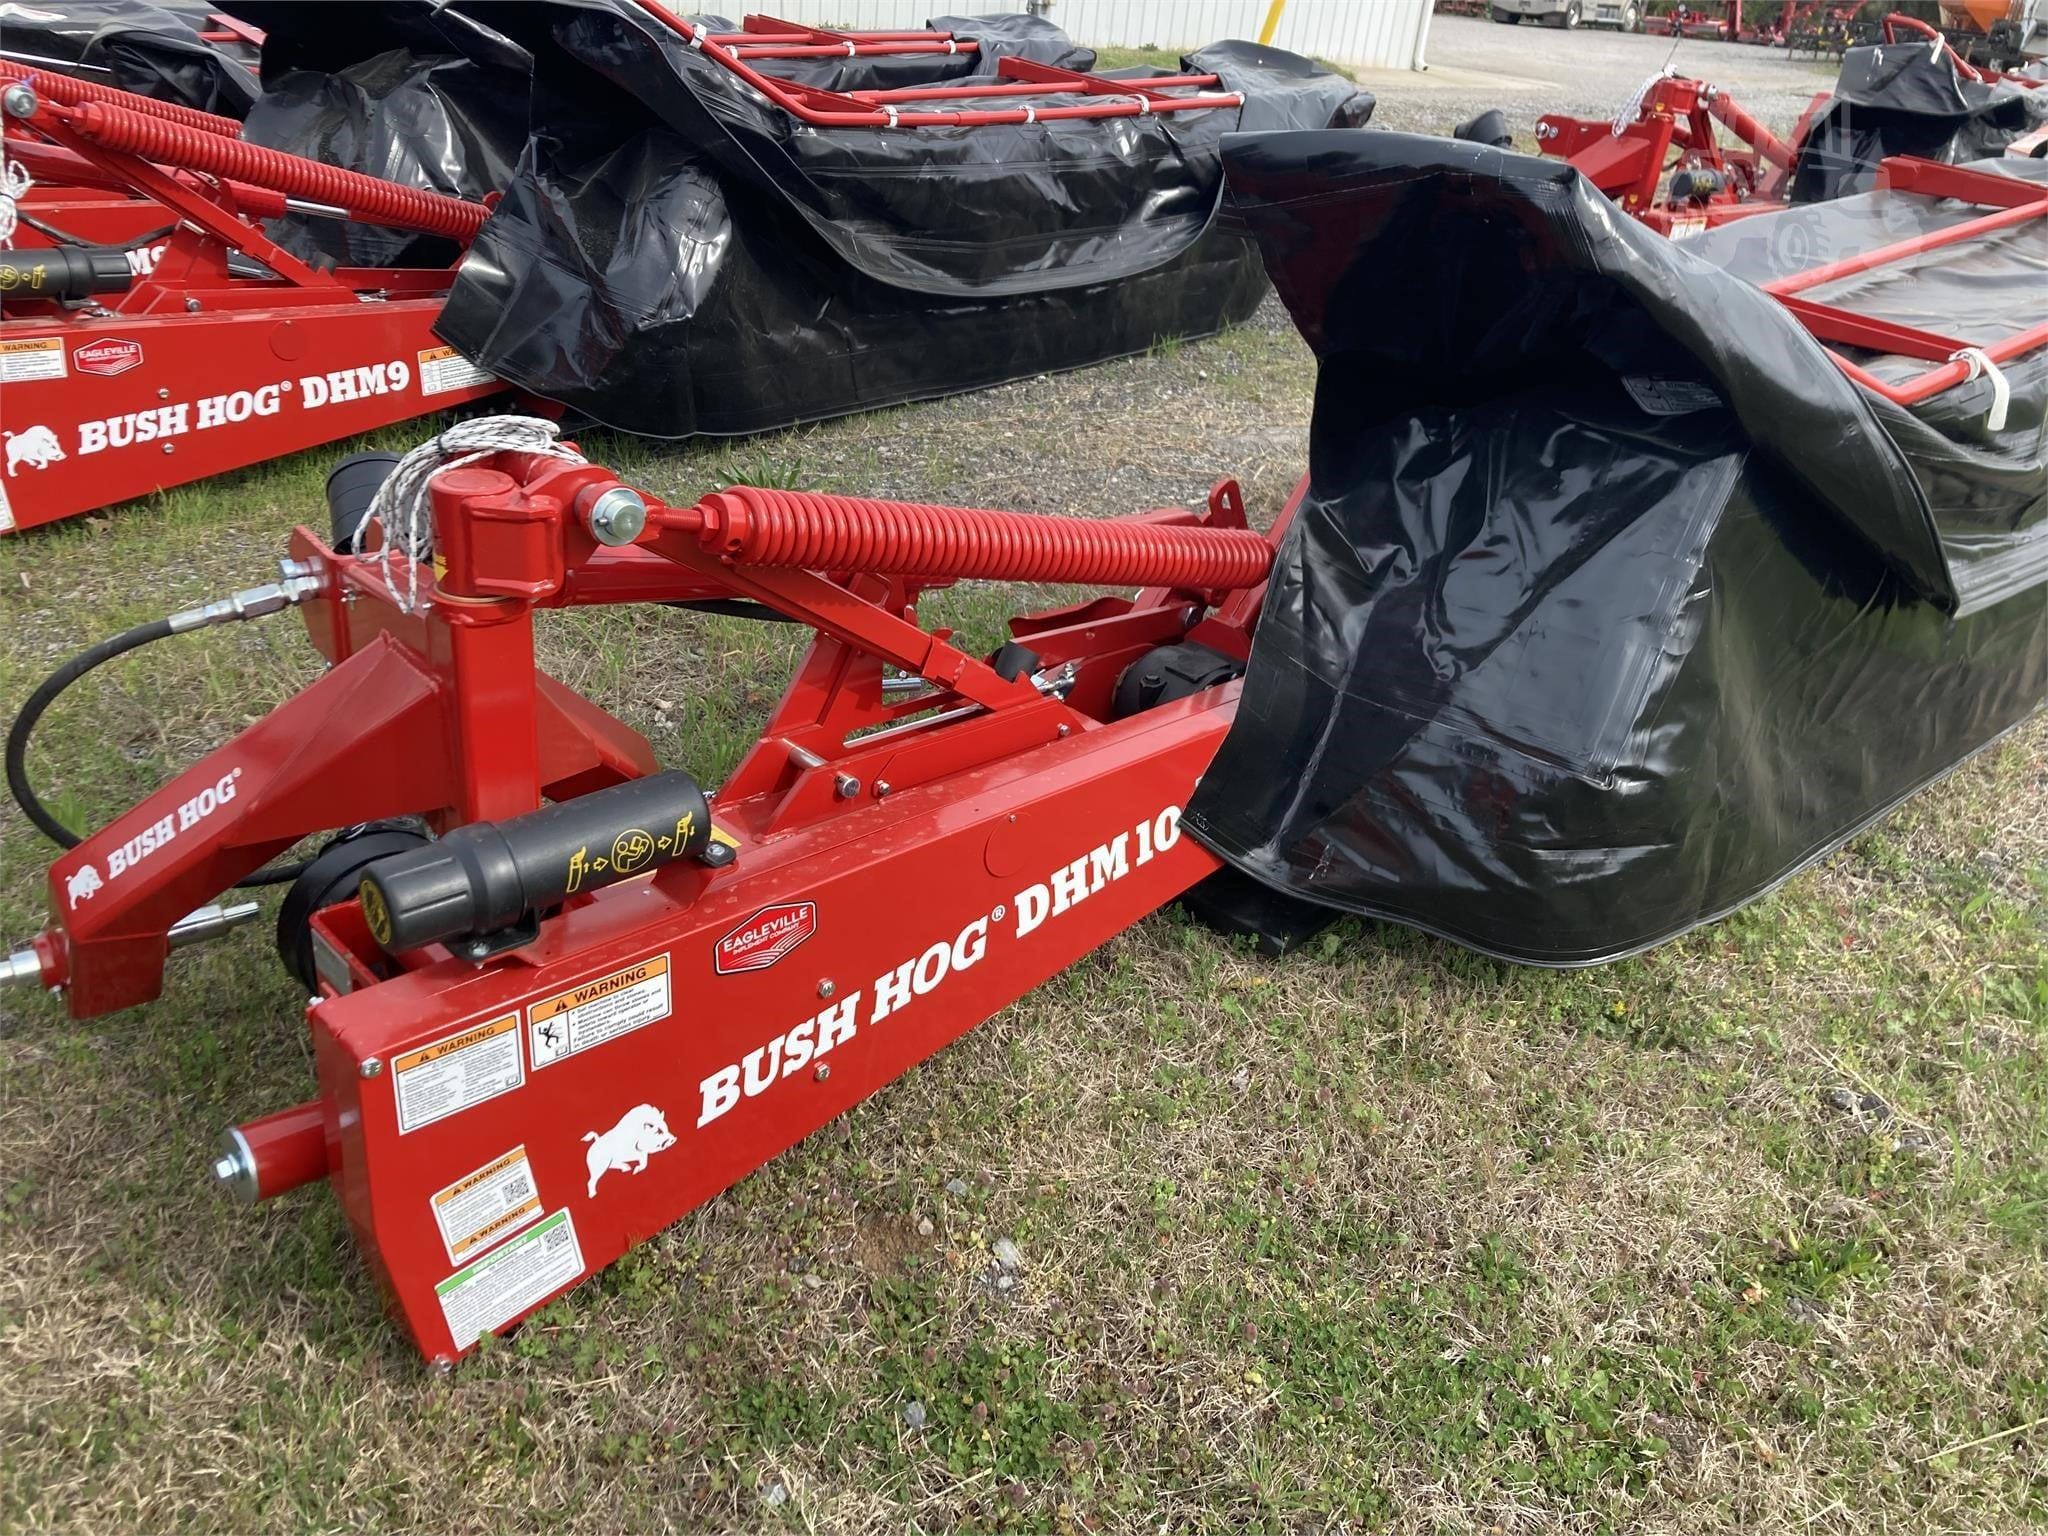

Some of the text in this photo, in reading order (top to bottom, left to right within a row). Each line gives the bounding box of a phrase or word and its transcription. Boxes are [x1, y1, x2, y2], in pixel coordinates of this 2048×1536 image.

[2, 341, 48, 352] WARNING
[78, 345, 138, 359] EAGLEVILLE
[78, 403, 189, 456] BUSH
[299, 361, 410, 410] DHM9
[107, 813, 177, 880] BUSH
[723, 906, 809, 953] EAGLEVILLE
[574, 967, 647, 1004] WARNING
[696, 992, 861, 1130] BUSH
[1013, 829, 1131, 939] DHM
[1134, 804, 1182, 868] 10
[437, 1026, 496, 1055] WARNING
[463, 1158, 511, 1189] WARNING
[479, 1206, 526, 1238] WARNING
[471, 1235, 529, 1275] IMPORTANT
